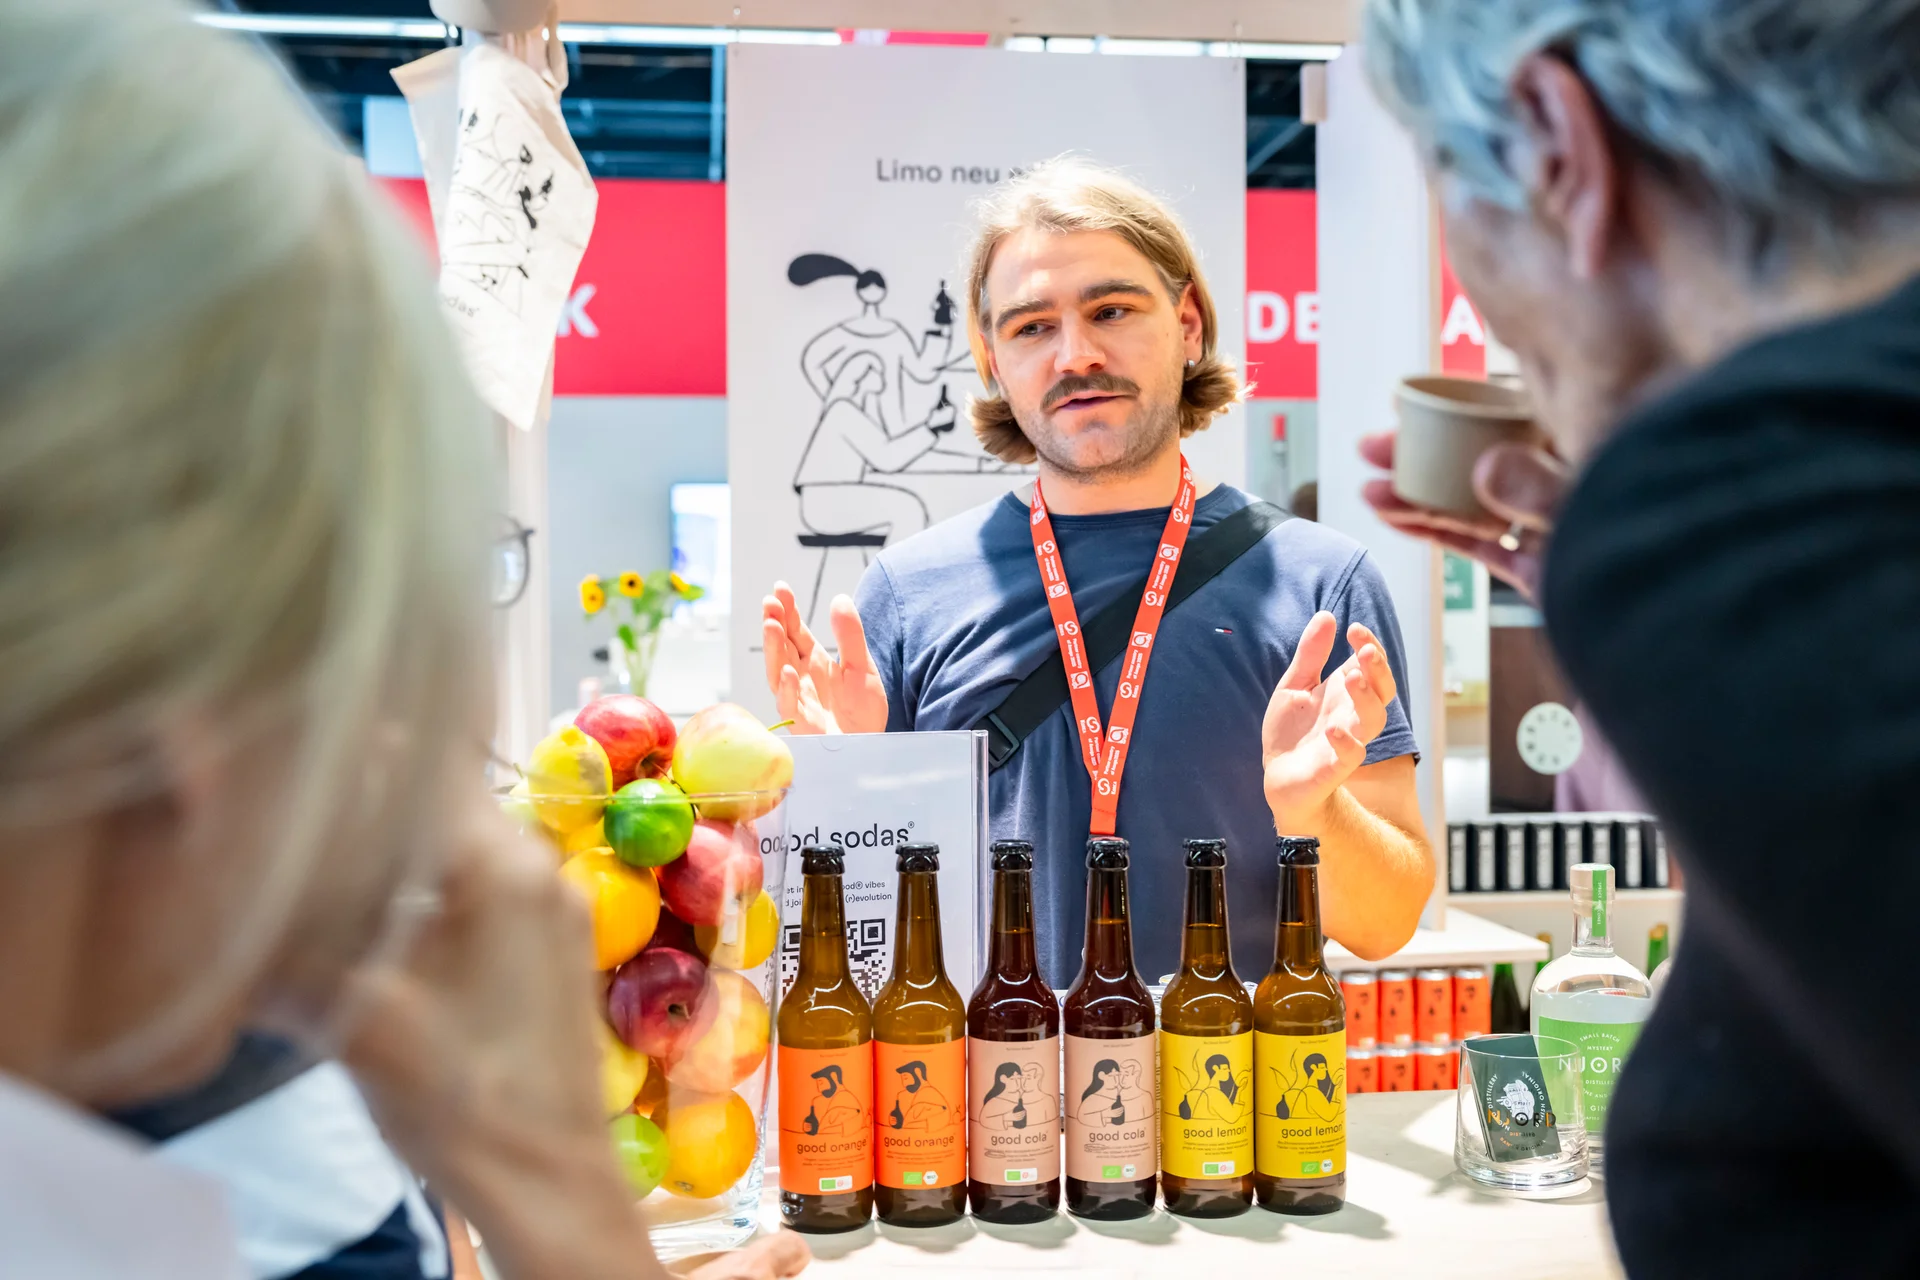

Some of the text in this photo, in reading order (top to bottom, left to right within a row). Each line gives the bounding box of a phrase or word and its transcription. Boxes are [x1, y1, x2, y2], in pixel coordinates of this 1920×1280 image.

[876, 158, 943, 183] Limo
[951, 165, 1000, 183] neu
[865, 880, 886, 890] vibes
[845, 893, 892, 904] (r)evolution
[1580, 1032, 1620, 1043] SMALL BATCH
[1089, 1129, 1145, 1143] good cola
[1184, 1125, 1247, 1139] good lemon
[1281, 1123, 1343, 1139] good lemon
[884, 1135, 955, 1148] good orange
[991, 1131, 1047, 1146] good cola
[796, 1138, 867, 1155] good orange
